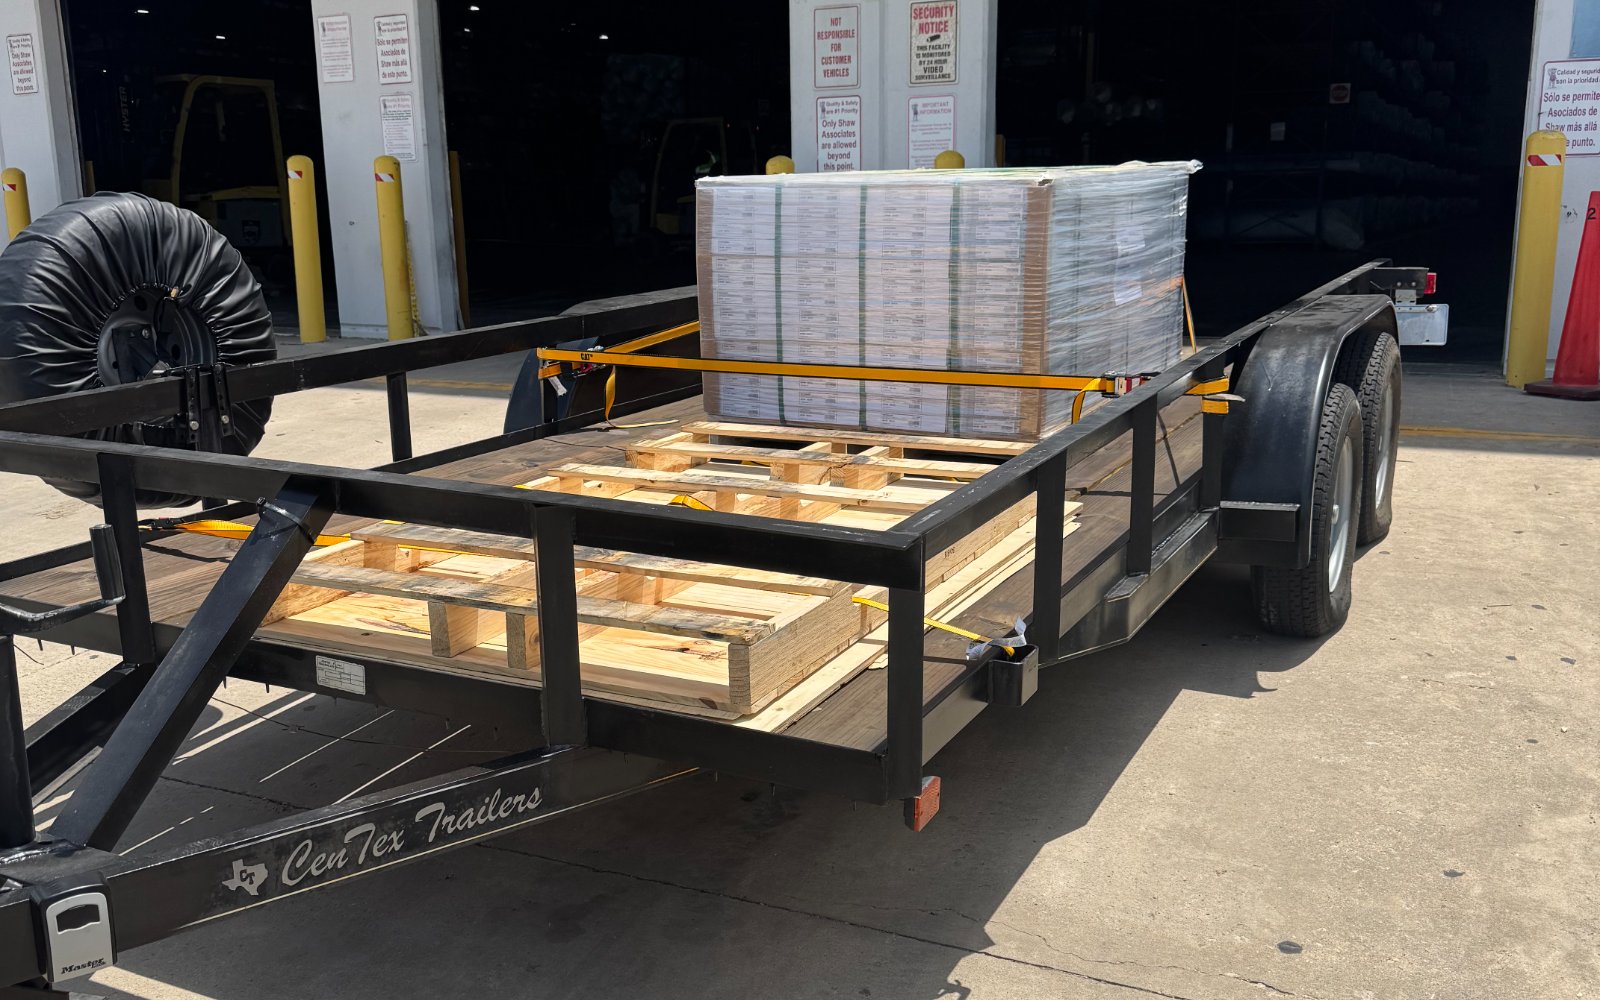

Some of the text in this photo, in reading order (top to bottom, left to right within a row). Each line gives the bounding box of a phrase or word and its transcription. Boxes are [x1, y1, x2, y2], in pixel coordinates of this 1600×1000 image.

[913, 5, 954, 20] SECURITY
[831, 17, 841, 26] NOT
[919, 21, 949, 35] NOTICE
[817, 29, 855, 40] RESPONSIBLE
[831, 43, 841, 52] FOR
[821, 55, 851, 65] CUSTOMER
[823, 68, 849, 78] VEHICLES
[1574, 76, 1598, 85] prioridad
[1544, 92, 1560, 102] Sólo
[1548, 106, 1598, 118] Asociados de
[822, 119, 855, 129] Only Shaw
[1567, 122, 1582, 131] más
[1584, 121, 1597, 131] allá
[822, 130, 856, 138] Associates
[833, 140, 856, 149] allowed
[1572, 137, 1595, 149] punto.
[828, 152, 850, 161] beyond
[837, 162, 854, 172] point.
[1588, 208, 1596, 220] 2
[282, 788, 542, 886] CenTex Trailers
[61, 957, 106, 974] Master
